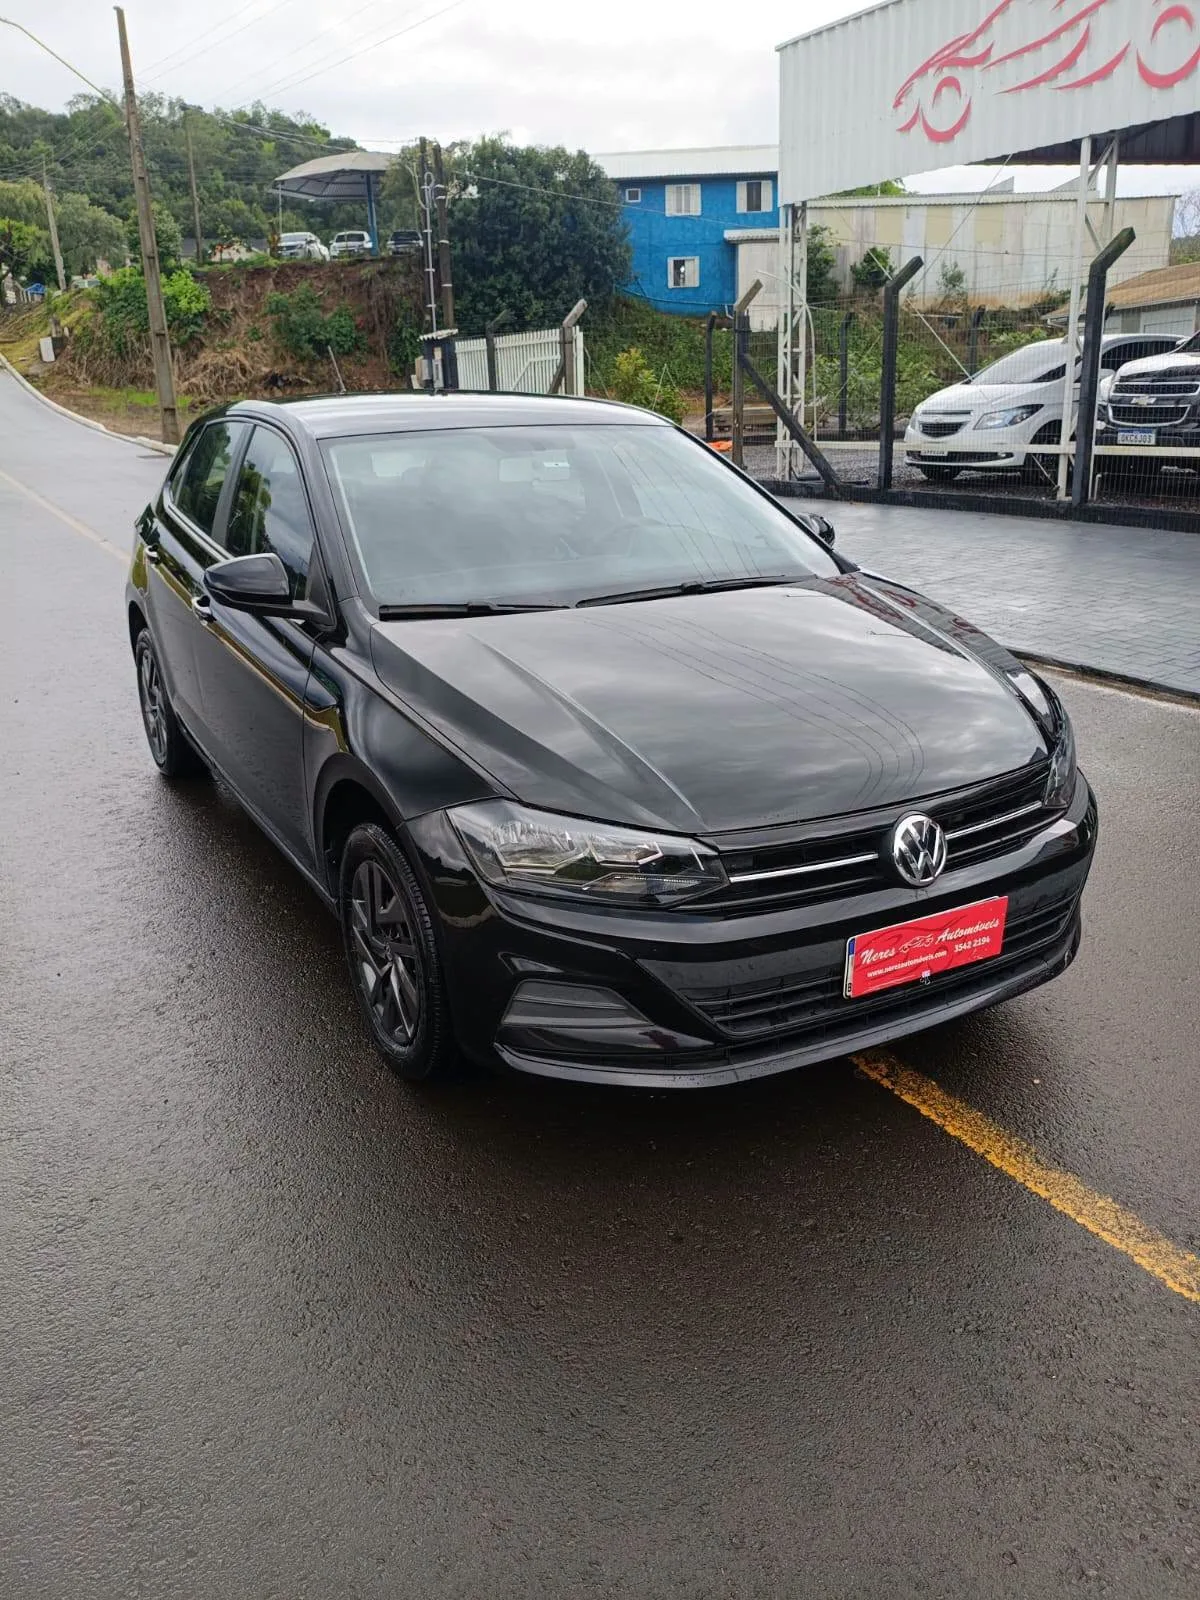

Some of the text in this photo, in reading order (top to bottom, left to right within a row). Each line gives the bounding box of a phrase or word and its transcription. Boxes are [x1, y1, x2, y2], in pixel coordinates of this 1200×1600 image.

[860, 918, 1000, 965] Neres Automóveis
[953, 940, 972, 953] 3542
